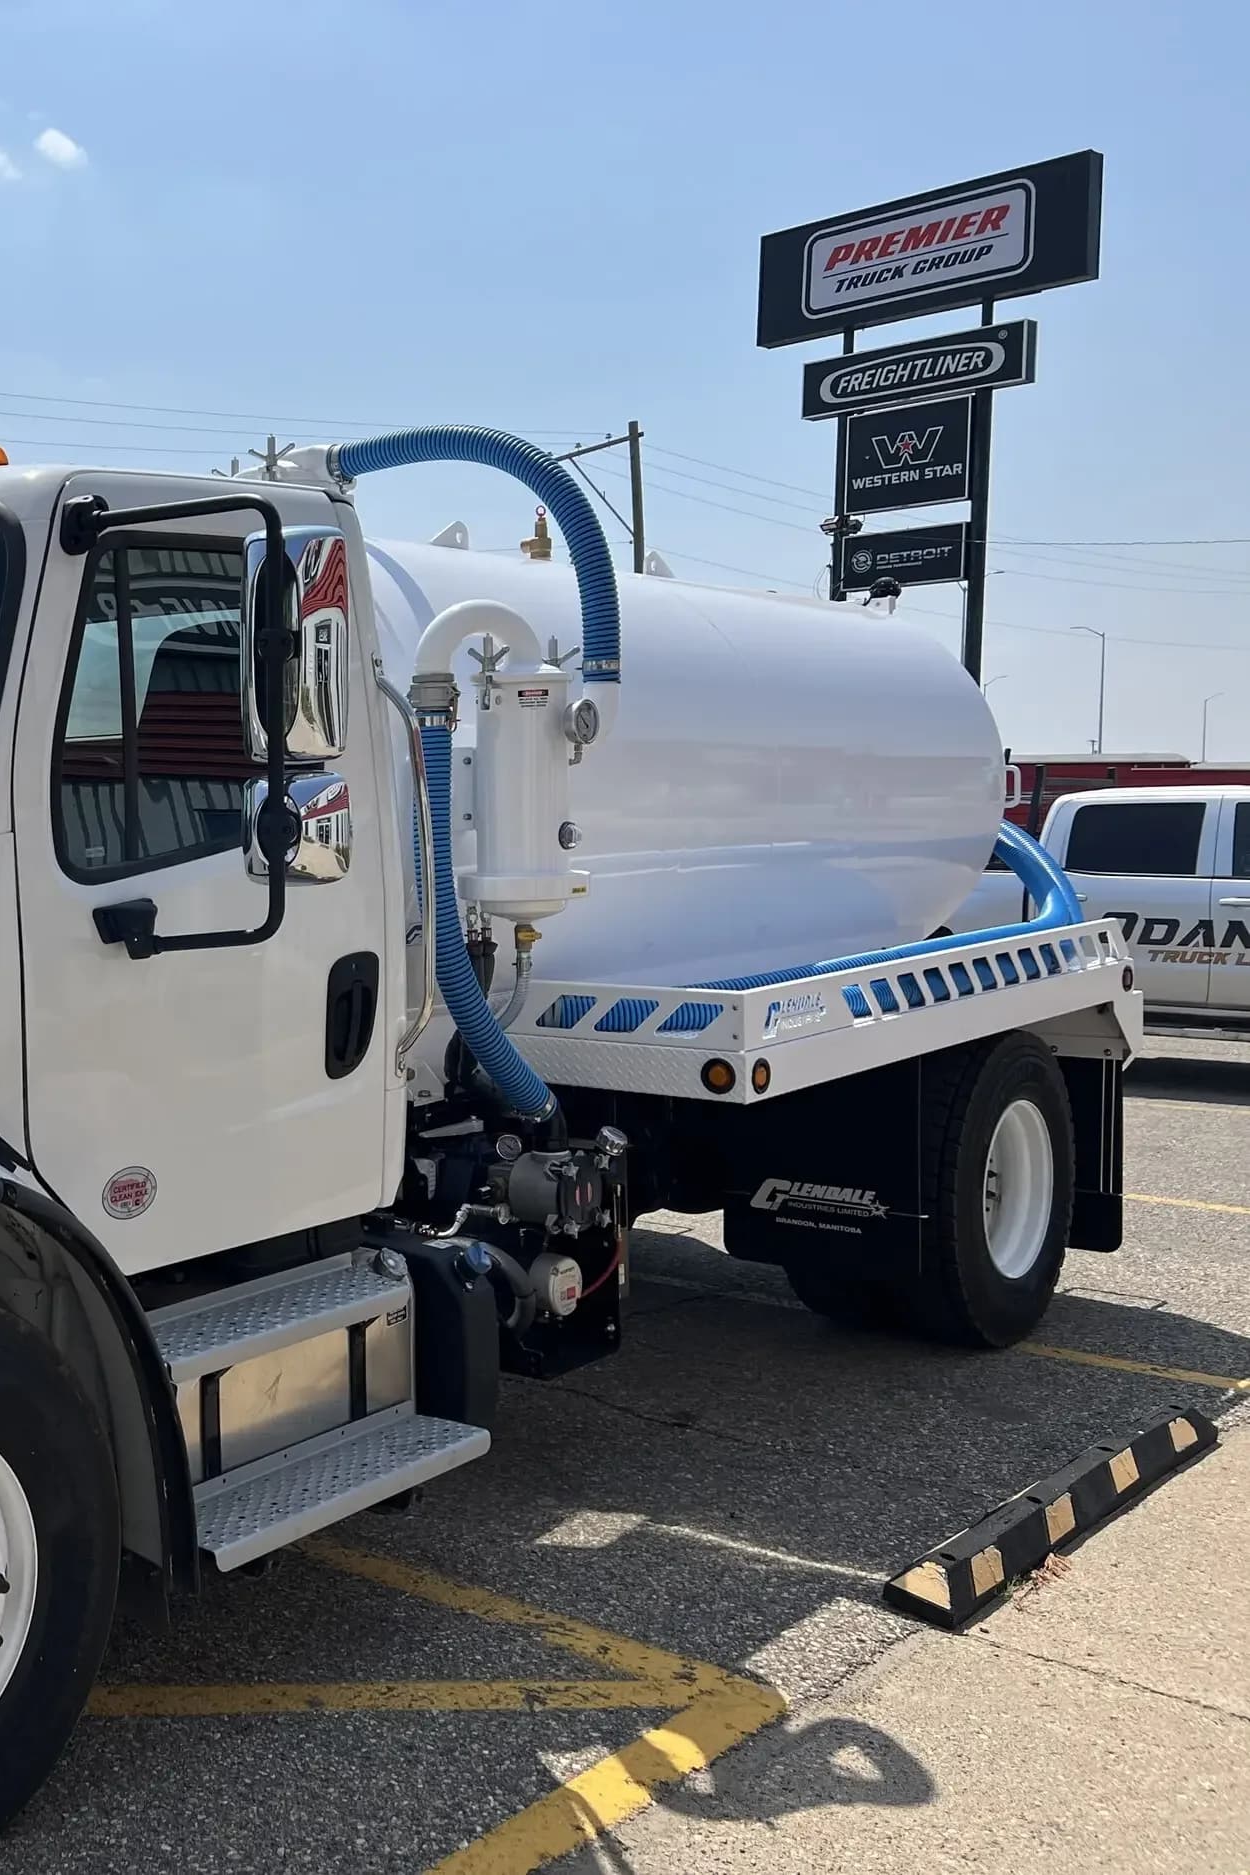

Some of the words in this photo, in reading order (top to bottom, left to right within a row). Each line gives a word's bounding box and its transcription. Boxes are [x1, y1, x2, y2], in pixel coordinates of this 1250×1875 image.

[823, 204, 1011, 272] PREMIER
[834, 263, 910, 294] TRUCK
[911, 244, 994, 275] GROUP
[836, 350, 986, 395] FREIGHTLINER
[852, 469, 920, 490] WESTERN
[924, 463, 963, 479] STAR
[876, 546, 953, 565] DETROIT
[1148, 950, 1232, 965] TRUCK
[749, 1178, 876, 1211] GLENDALE
[787, 1200, 835, 1214] INDUSTRIES
[836, 1207, 870, 1218] LIMITED
[775, 1216, 817, 1228] BRANDON,
[818, 1222, 862, 1234] MANITOBA
